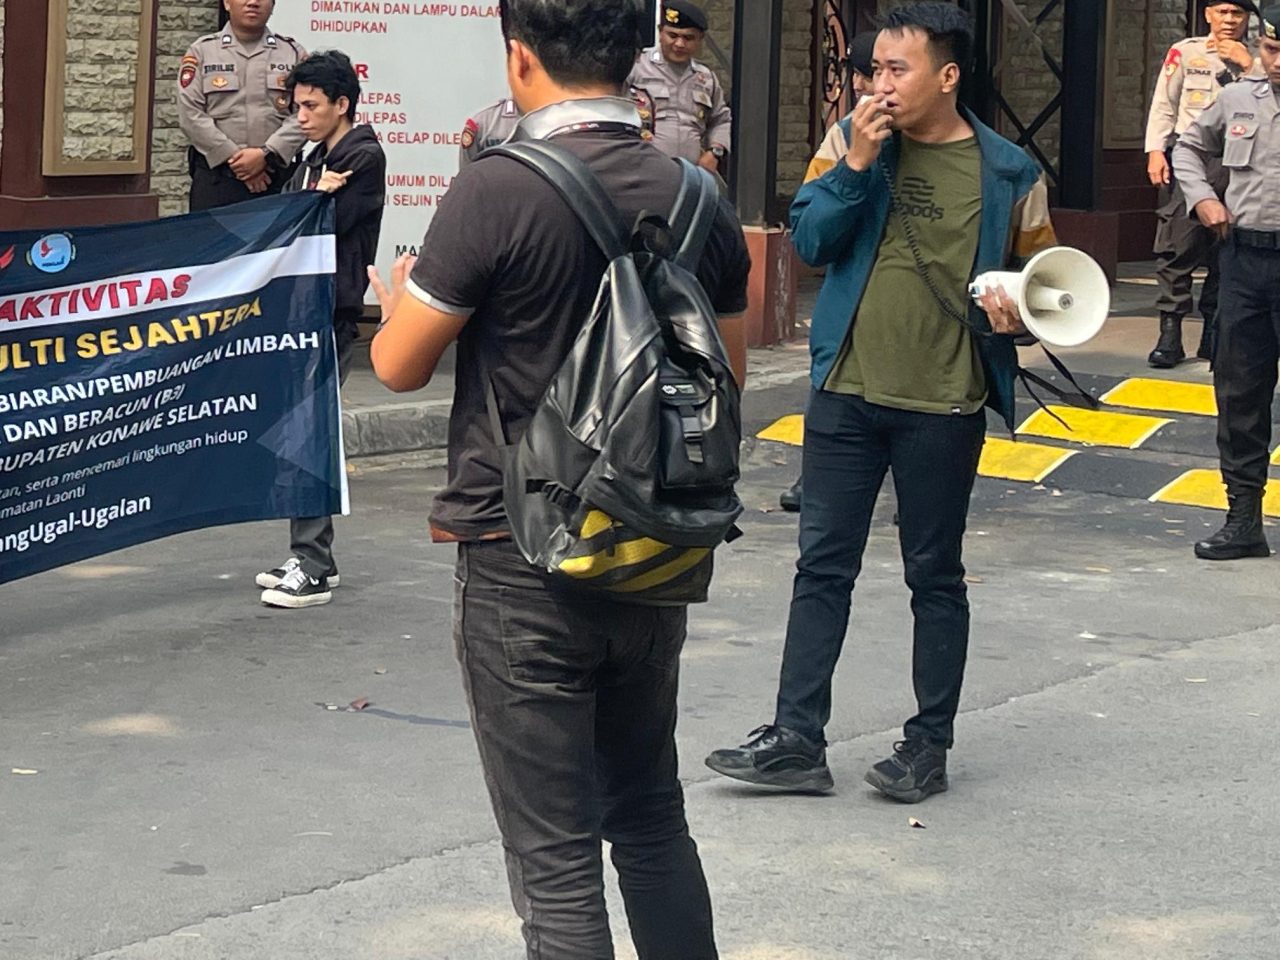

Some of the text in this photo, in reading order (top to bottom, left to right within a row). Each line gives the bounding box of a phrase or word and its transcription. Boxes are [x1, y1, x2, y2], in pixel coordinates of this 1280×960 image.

[311, 0, 380, 15] DIMATIKAN
[383, 3, 410, 15] DAN
[413, 3, 457, 17] LAMPU
[310, 19, 388, 34] DIHIDUPKAN
[387, 131, 430, 144] GELAP
[387, 175, 425, 187] UMUM
[393, 194, 432, 207] SEIJIN
[76, 296, 262, 360] SEJAHTERA
[224, 331, 320, 358] LIMBAH
[3, 416, 58, 443] DAN
[63, 394, 153, 433] BERACUN
[154, 383, 186, 410] (B3)
[86, 412, 165, 451] KONAWE
[166, 393, 258, 427] SELATAN
[25, 475, 59, 494] serta
[61, 453, 130, 484] mencemari
[132, 436, 202, 462] lingkungan
[205, 428, 248, 445] hidup
[45, 483, 87, 507] Laonti
